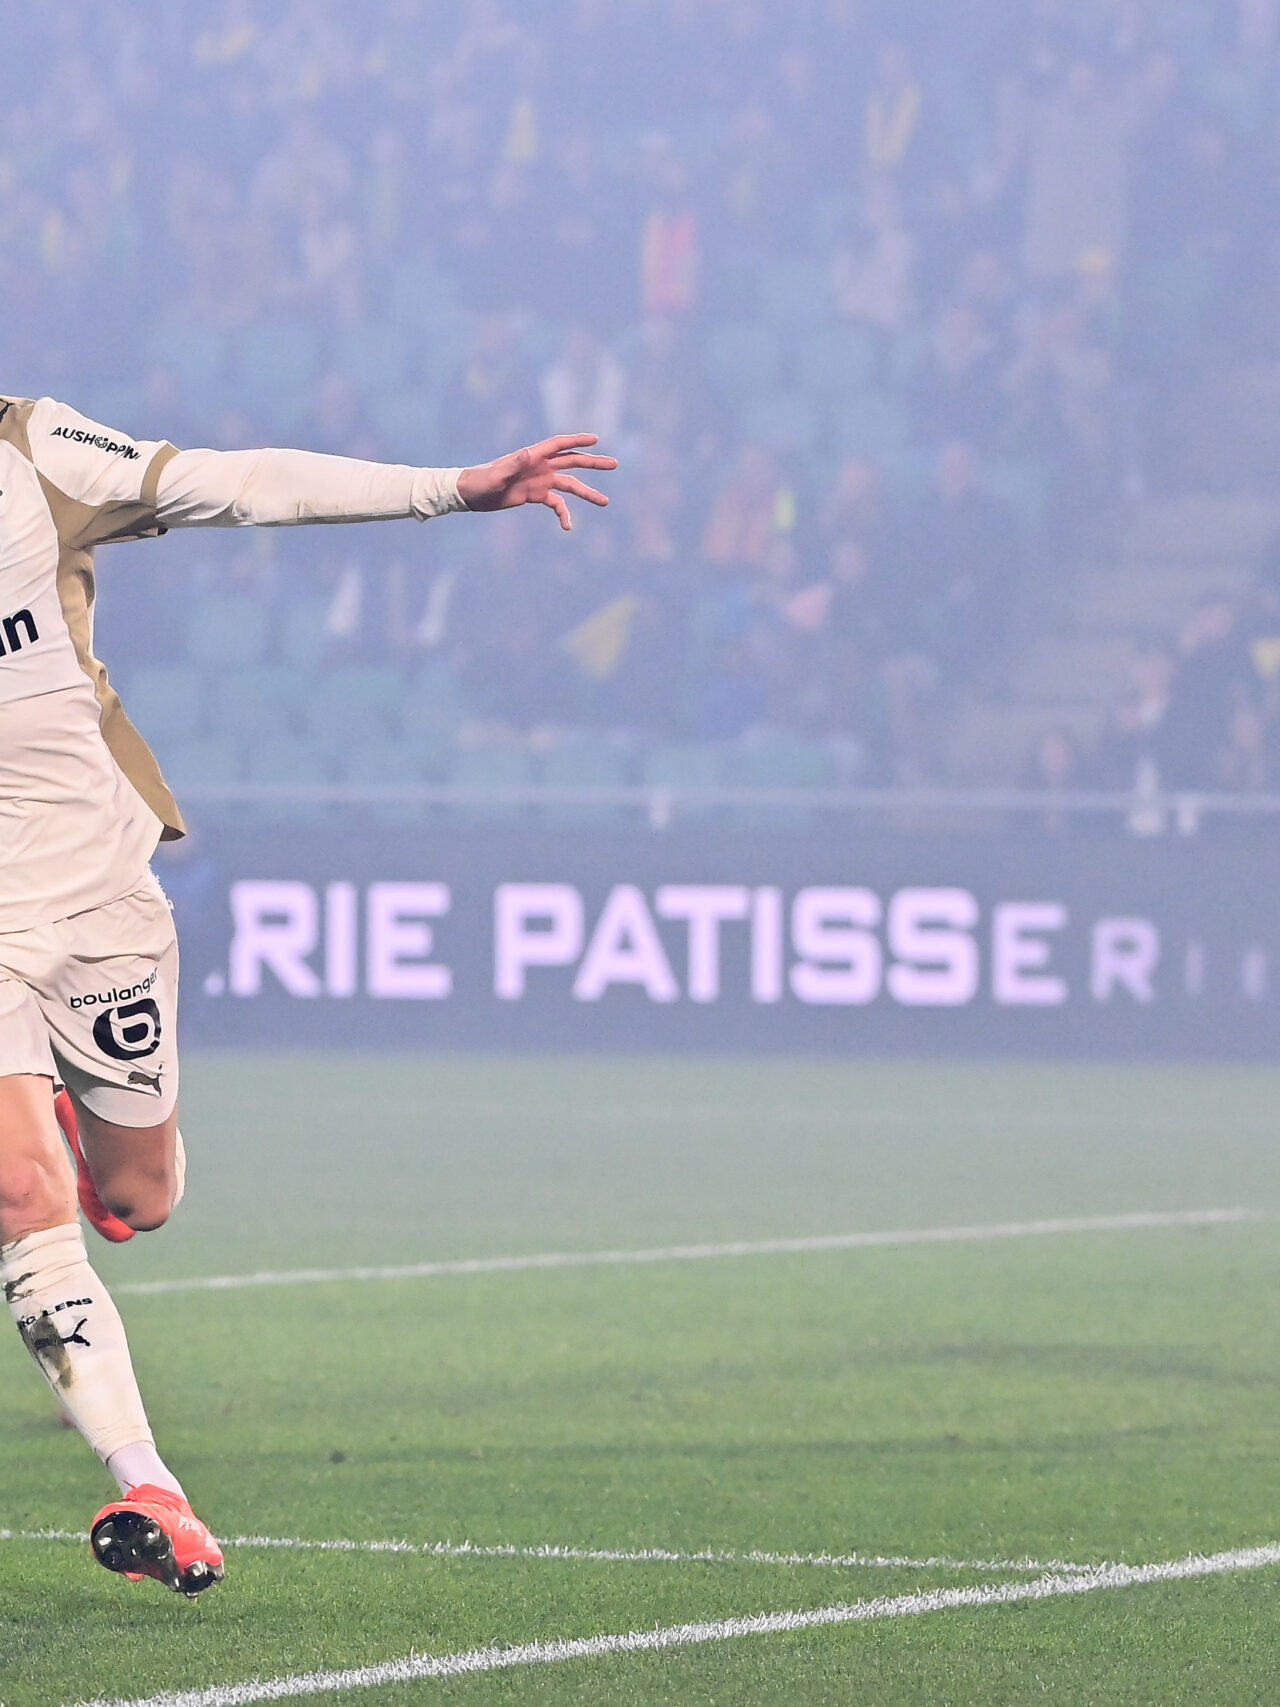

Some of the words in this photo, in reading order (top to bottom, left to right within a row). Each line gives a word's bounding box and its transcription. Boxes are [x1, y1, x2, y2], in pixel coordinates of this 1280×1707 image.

[50, 427, 141, 460] AUSHOPPIN
[203, 880, 453, 998] RIE
[70, 966, 158, 1009] boulanger
[42, 1297, 93, 1317] LENS
